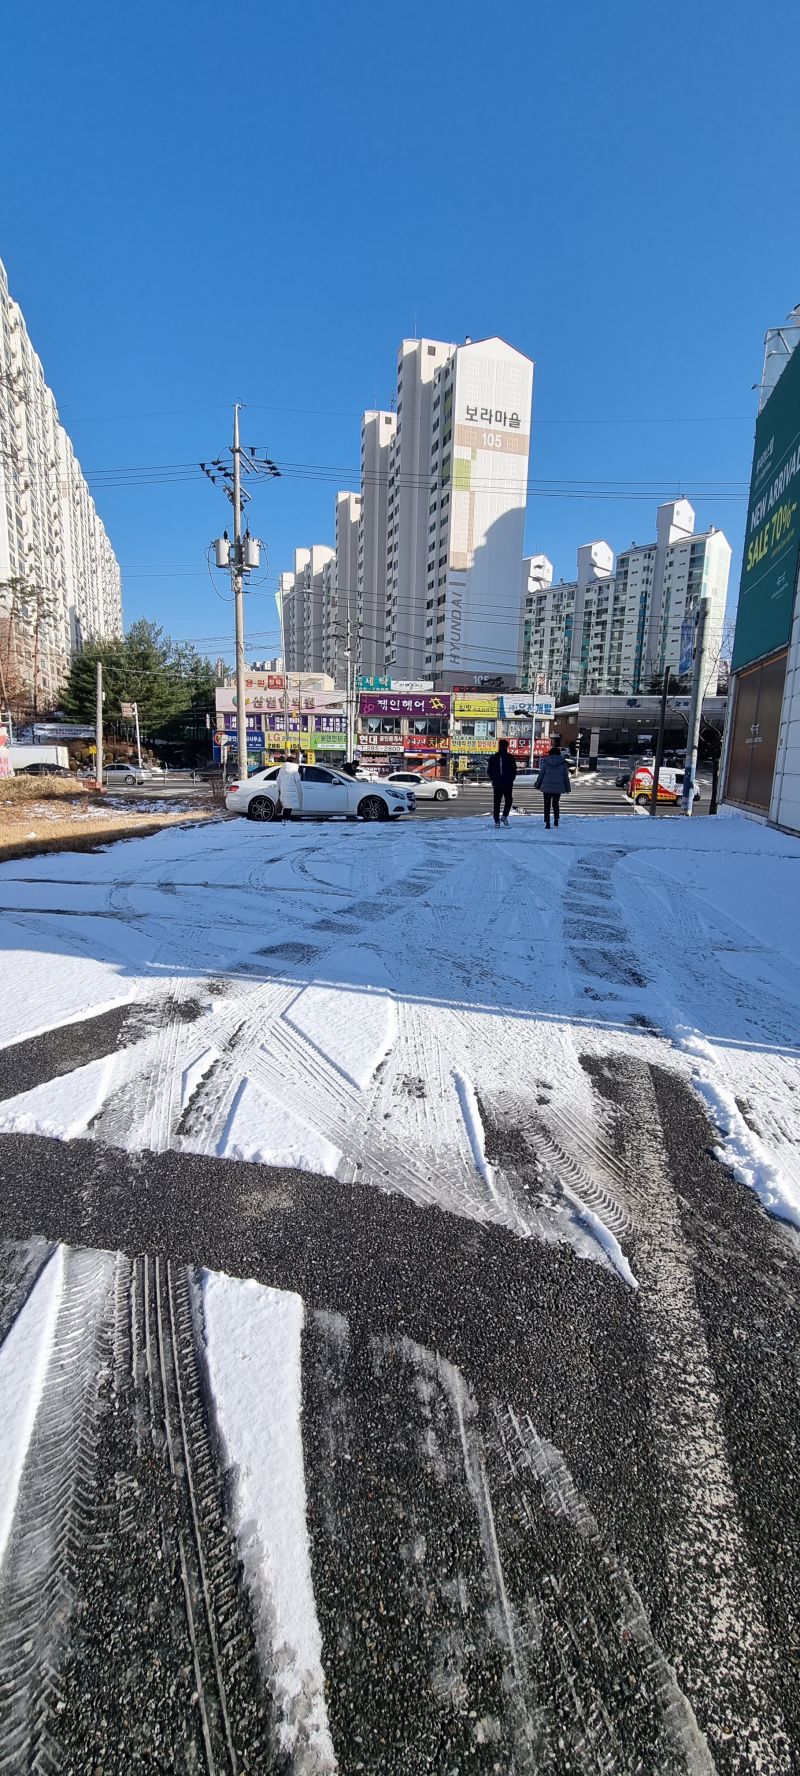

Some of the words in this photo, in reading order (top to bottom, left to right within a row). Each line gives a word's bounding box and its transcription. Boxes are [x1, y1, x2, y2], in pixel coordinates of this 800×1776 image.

[465, 405, 522, 428] 보라마을
[482, 432, 502, 448] 105
[750, 493, 768, 533] NEW
[747, 522, 770, 572] SALE
[450, 591, 463, 665] HYUNDAI
[366, 676, 388, 687] 세탁
[267, 733, 280, 742] LG
[359, 734, 378, 745] 현대
[428, 737, 449, 749] 치킨
